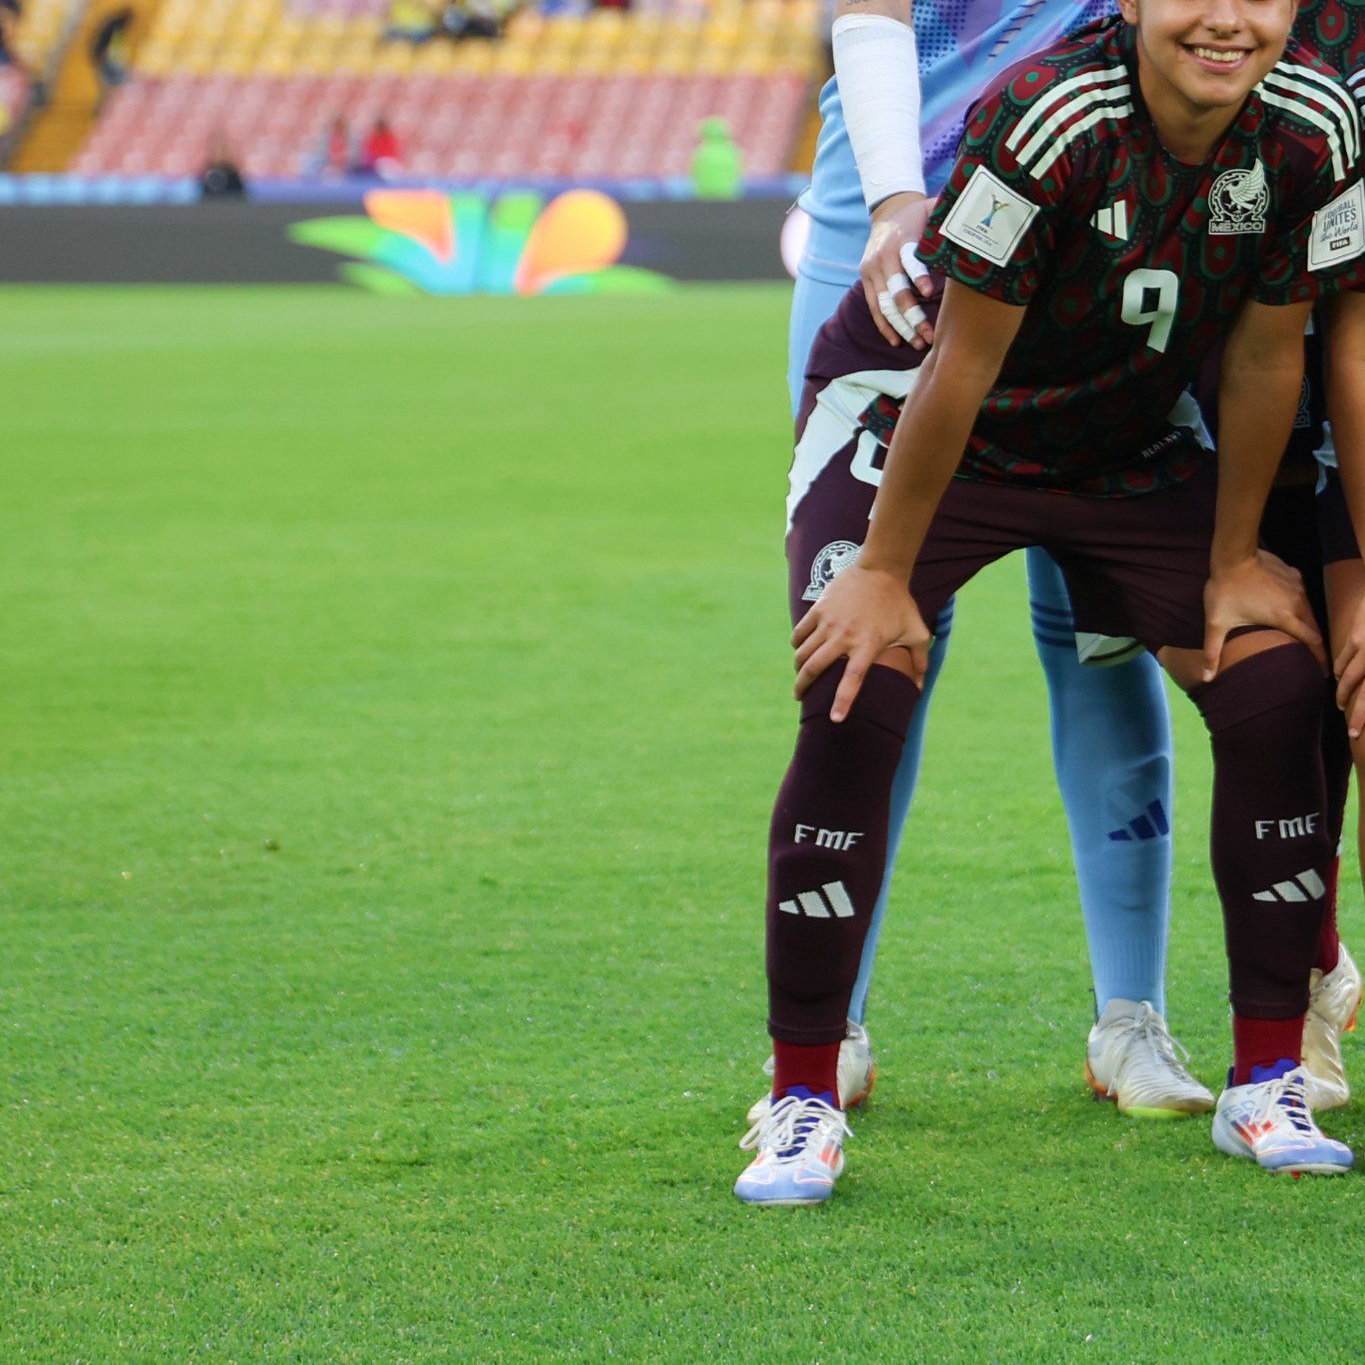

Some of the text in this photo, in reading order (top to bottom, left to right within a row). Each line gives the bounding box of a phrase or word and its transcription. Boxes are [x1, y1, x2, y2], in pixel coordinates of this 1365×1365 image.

[1322, 208, 1357, 233] UNITES
[1323, 199, 1357, 220] FOOTBALL
[1210, 220, 1263, 233] MÉXICO
[1121, 268, 1180, 353] 9
[794, 823, 865, 853] FMF
[1254, 812, 1321, 840] FMF
